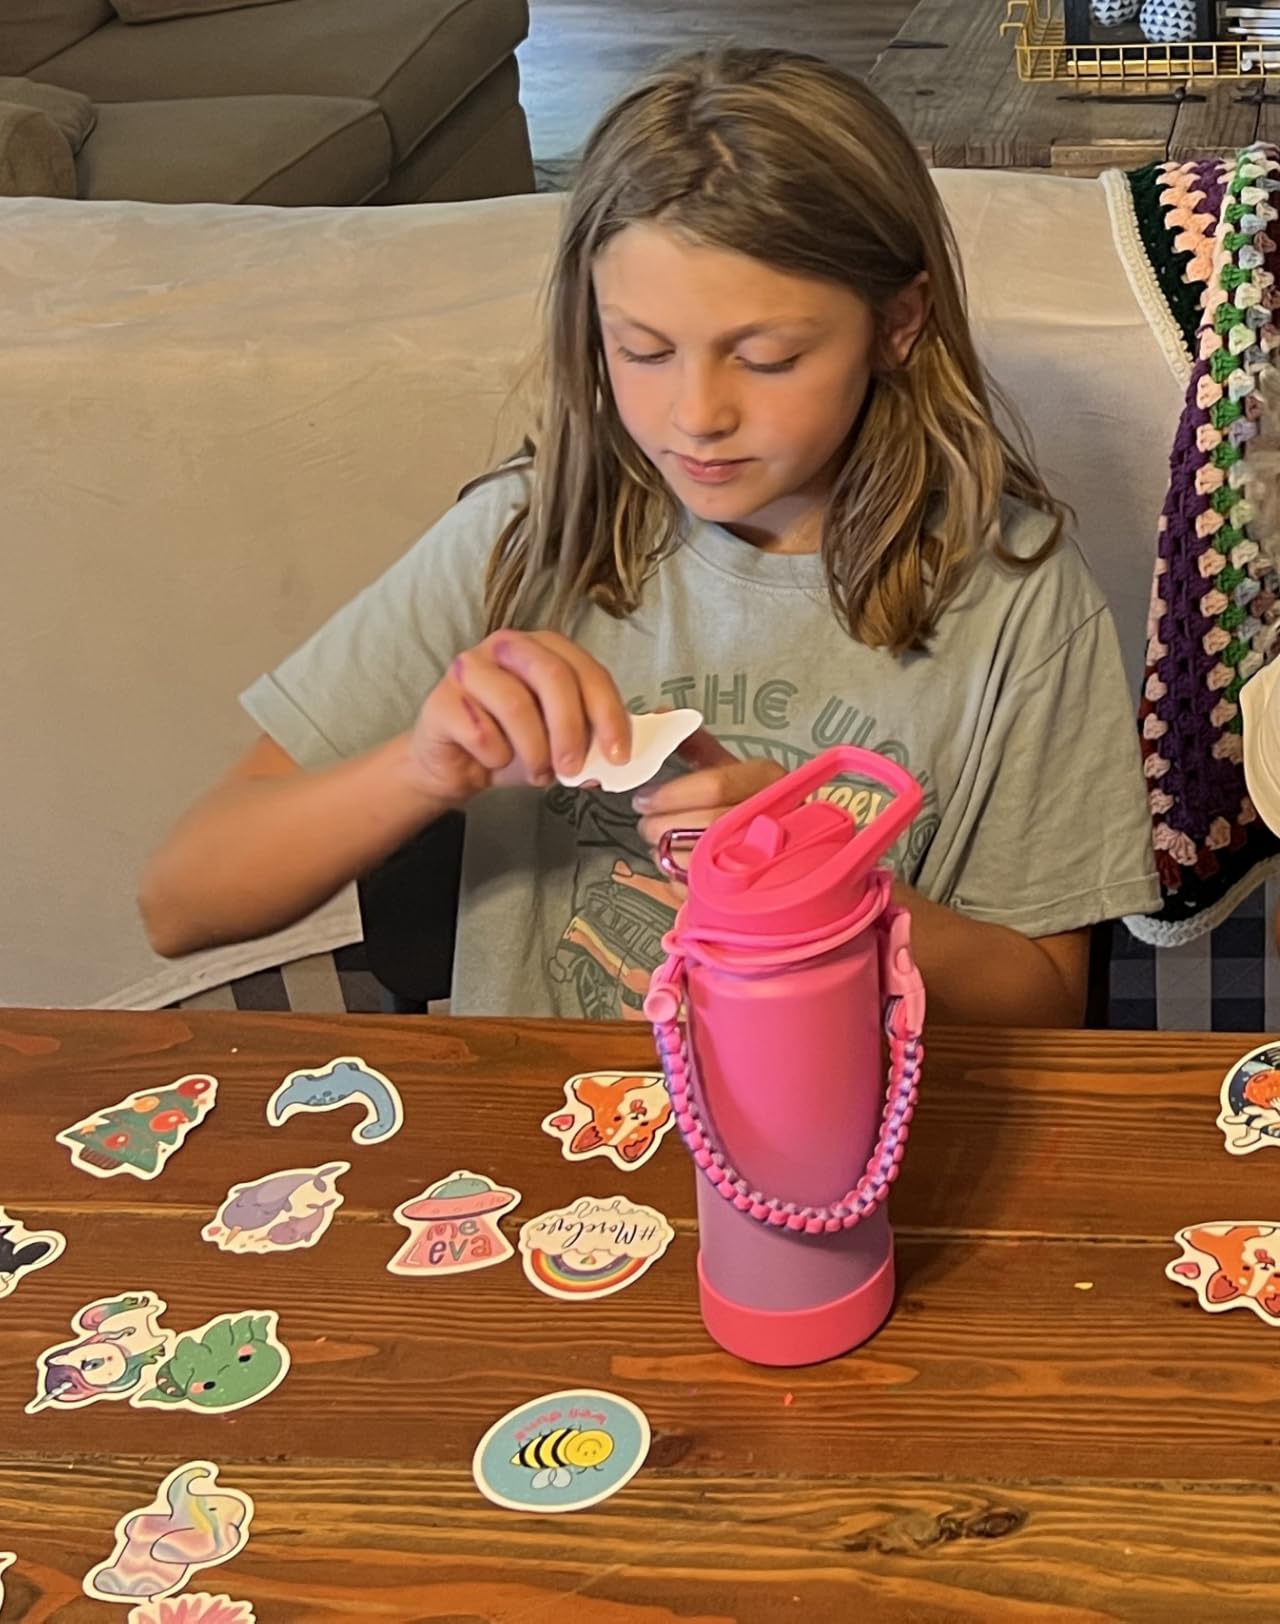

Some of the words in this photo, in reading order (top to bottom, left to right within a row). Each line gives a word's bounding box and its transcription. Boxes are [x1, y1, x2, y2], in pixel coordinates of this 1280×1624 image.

[661, 673, 798, 730] THE
[427, 1219, 480, 1241] me
[536, 1218, 657, 1248] #Morelove
